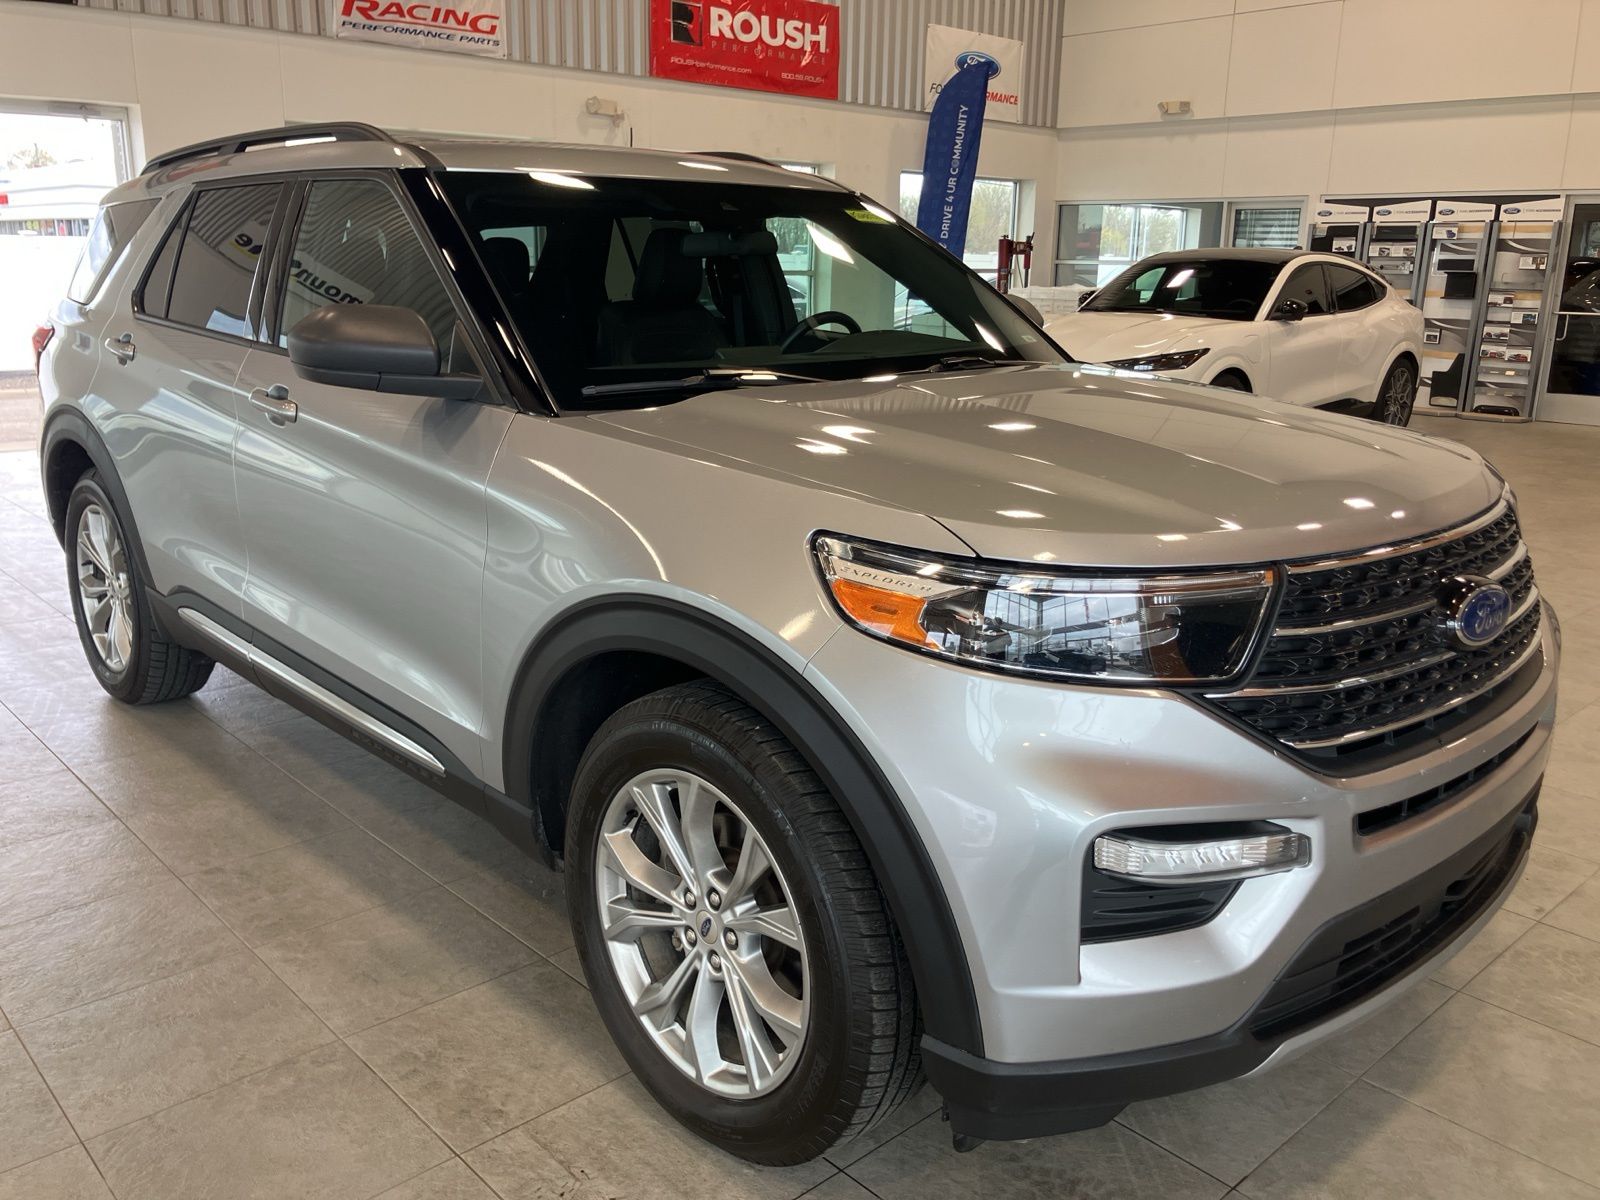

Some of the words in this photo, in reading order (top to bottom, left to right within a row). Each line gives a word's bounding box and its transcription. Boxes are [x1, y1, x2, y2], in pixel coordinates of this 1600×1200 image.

[341, 0, 500, 35] RACING
[342, 20, 456, 42] PERFORMANCE
[459, 35, 501, 47] PARTS
[709, 6, 828, 54] ROUSH
[711, 40, 826, 66] PERFORMANCE
[949, 104, 969, 175] COMMUNITY
[946, 177, 958, 194] UR
[940, 204, 954, 239] DRIVE
